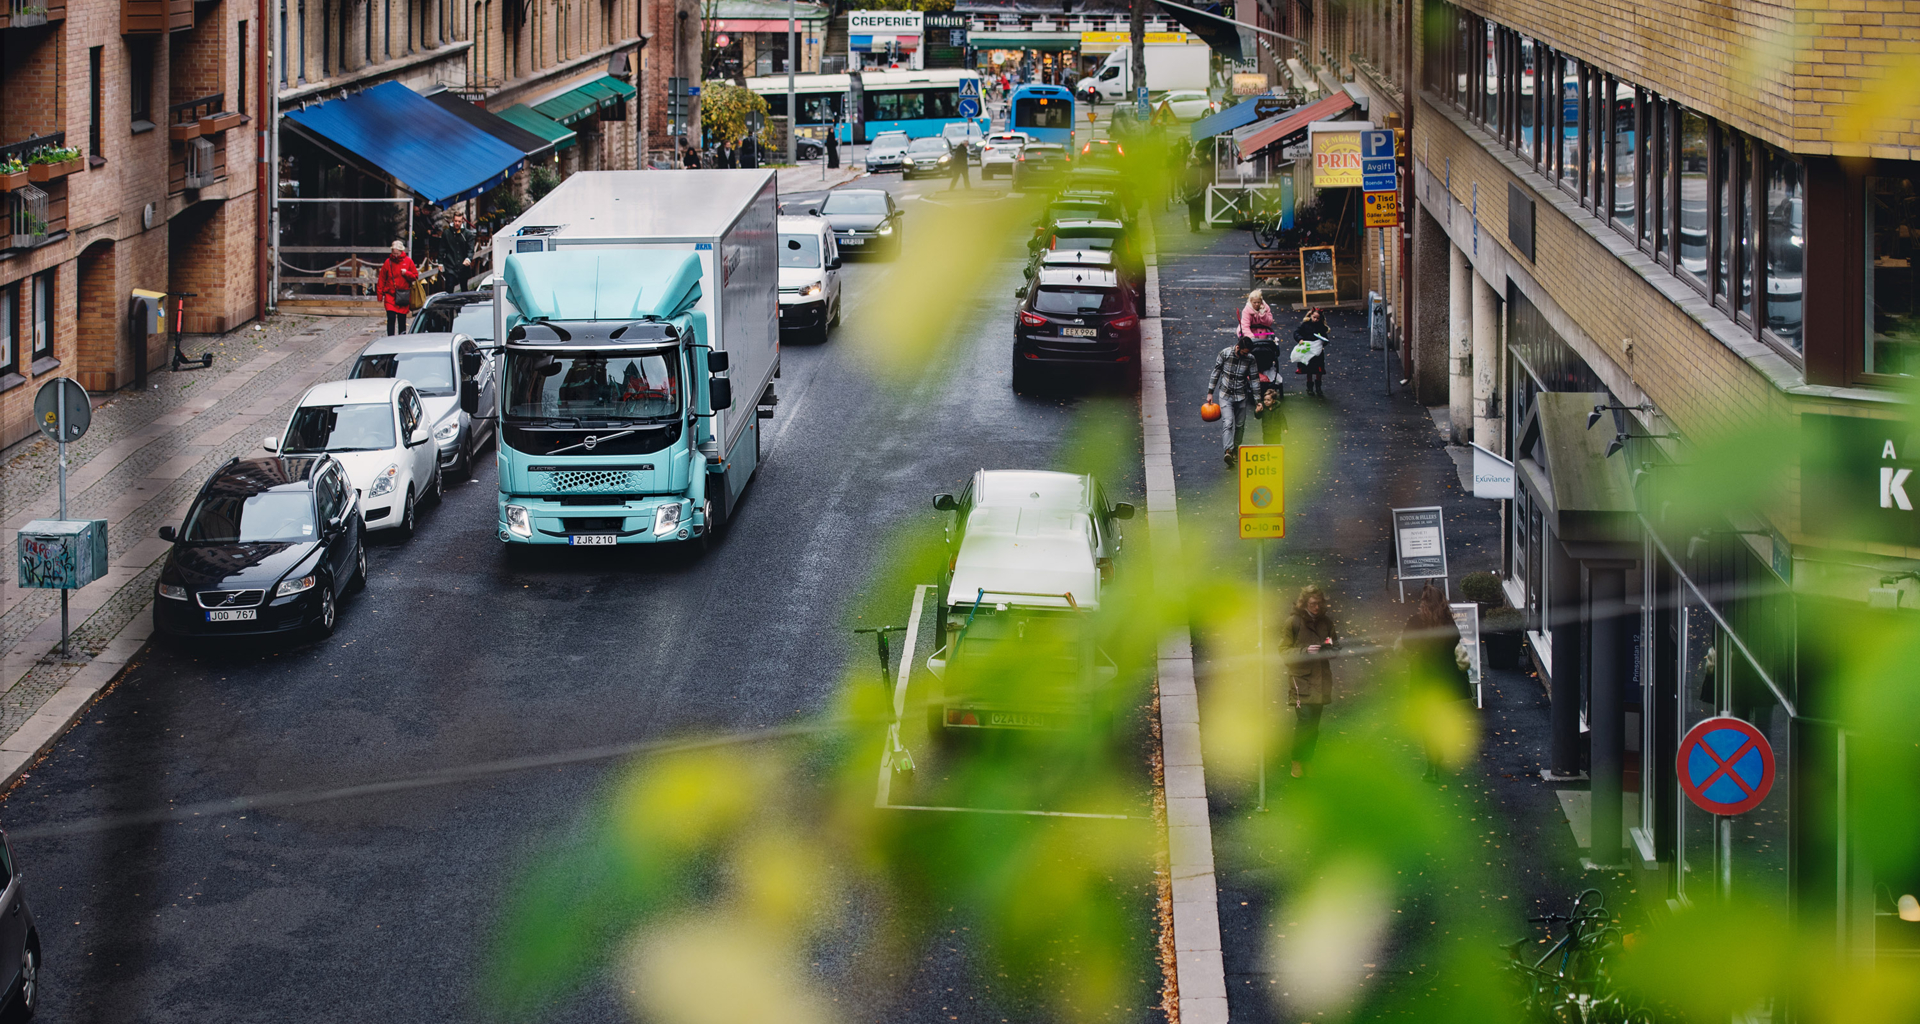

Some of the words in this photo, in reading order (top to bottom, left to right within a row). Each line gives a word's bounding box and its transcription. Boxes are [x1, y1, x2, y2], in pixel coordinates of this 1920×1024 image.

[852, 16, 920, 26] CREPERIET
[1319, 134, 1361, 152] HEMBAGE
[1370, 133, 1386, 156] P
[1317, 154, 1361, 168] PRIN
[1367, 163, 1391, 172] Avgift
[1319, 176, 1362, 184] KONDITO
[1246, 452, 1278, 462] Last-
[1246, 465, 1277, 478] plats
[1476, 474, 1511, 483] Exuviance
[1880, 467, 1914, 511] K
[576, 536, 594, 544] ZJR
[596, 536, 612, 544] 210
[236, 610, 254, 620] 767
[1633, 634, 1640, 642] 12
[1632, 645, 1640, 682] Prinsgatan
[993, 713, 1014, 724] CZA
